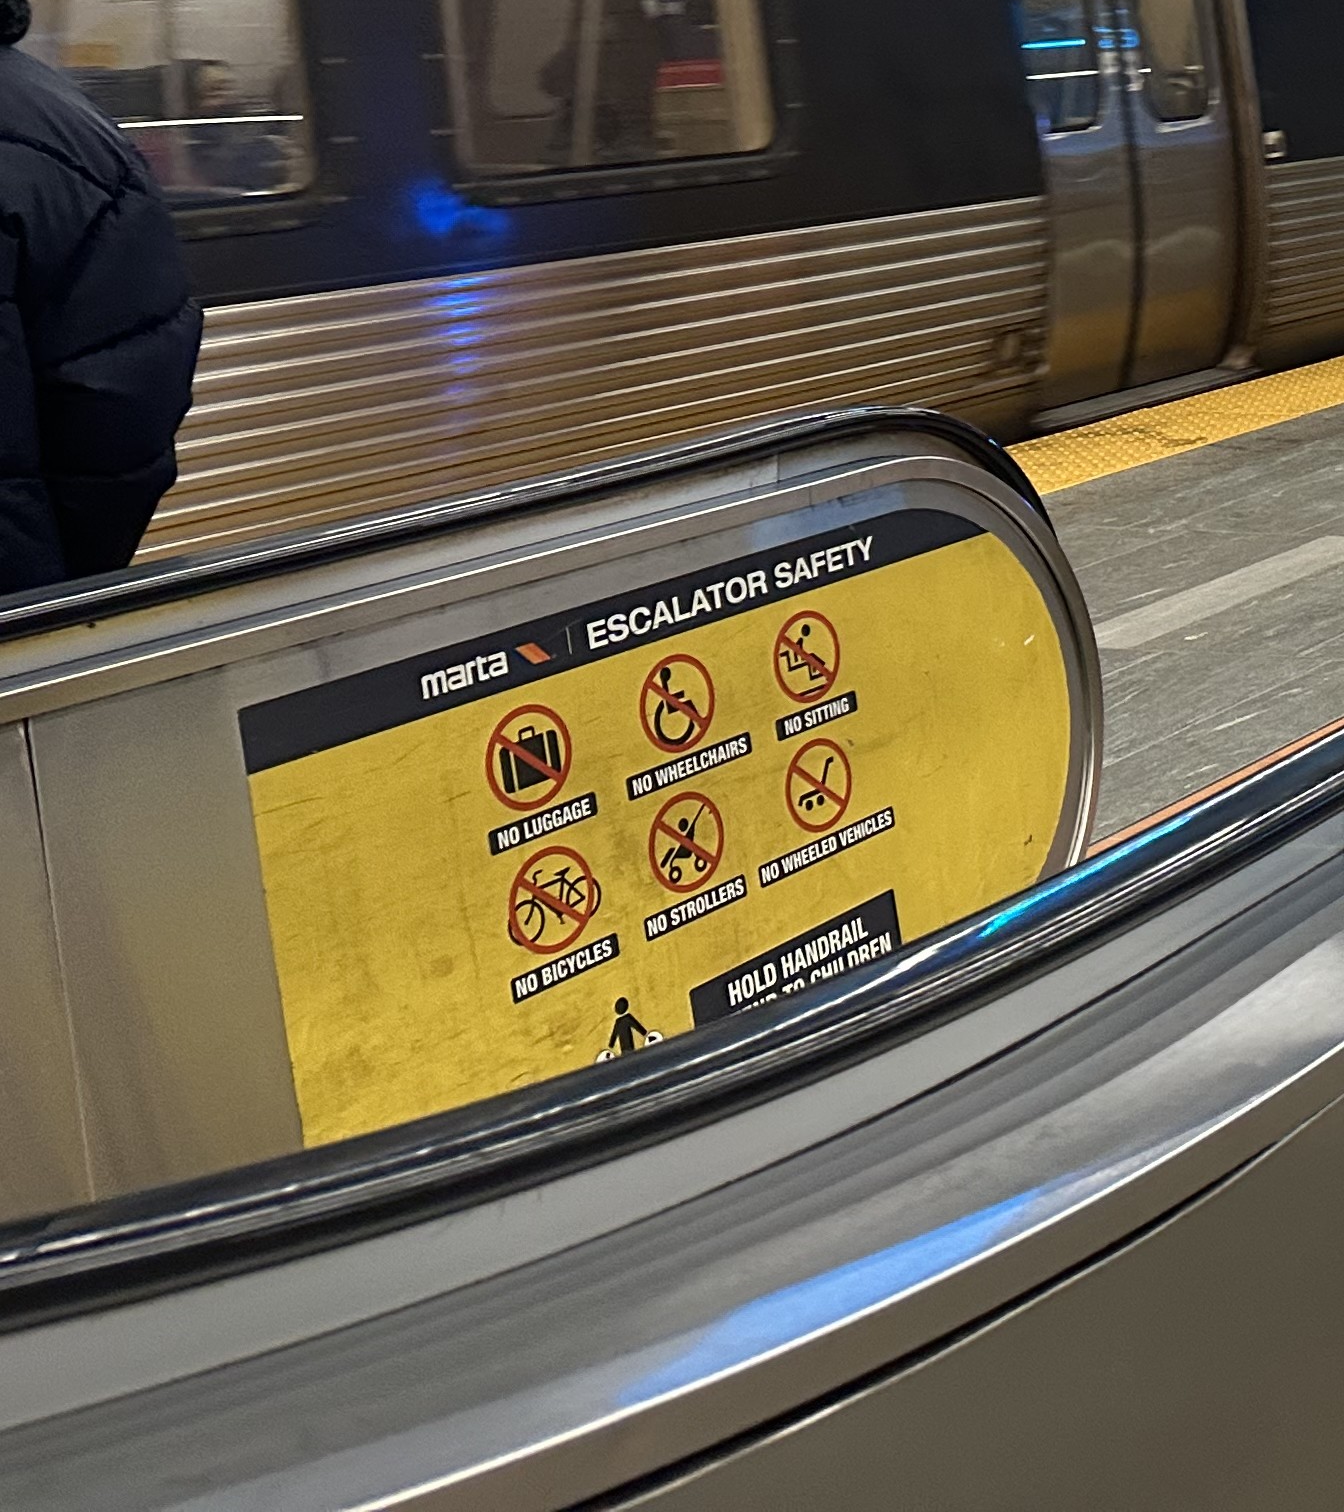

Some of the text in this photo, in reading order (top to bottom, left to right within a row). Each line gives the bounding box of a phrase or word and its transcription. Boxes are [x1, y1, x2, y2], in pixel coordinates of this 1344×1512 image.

[586, 536, 873, 650] ESCALATOR SAFETY
[421, 651, 508, 700] marta
[784, 697, 850, 737] NO SITTING
[631, 736, 748, 797] NO WHEELCHAIRS
[497, 798, 592, 850] NO LUGGAGE
[760, 810, 894, 884] NO WHEELED VEHICLES
[646, 878, 745, 938] NO STROLLERS
[515, 940, 613, 999] NO BICYCLES
[727, 962, 778, 1007] HOLD
[780, 916, 869, 979] HANDRAIL
